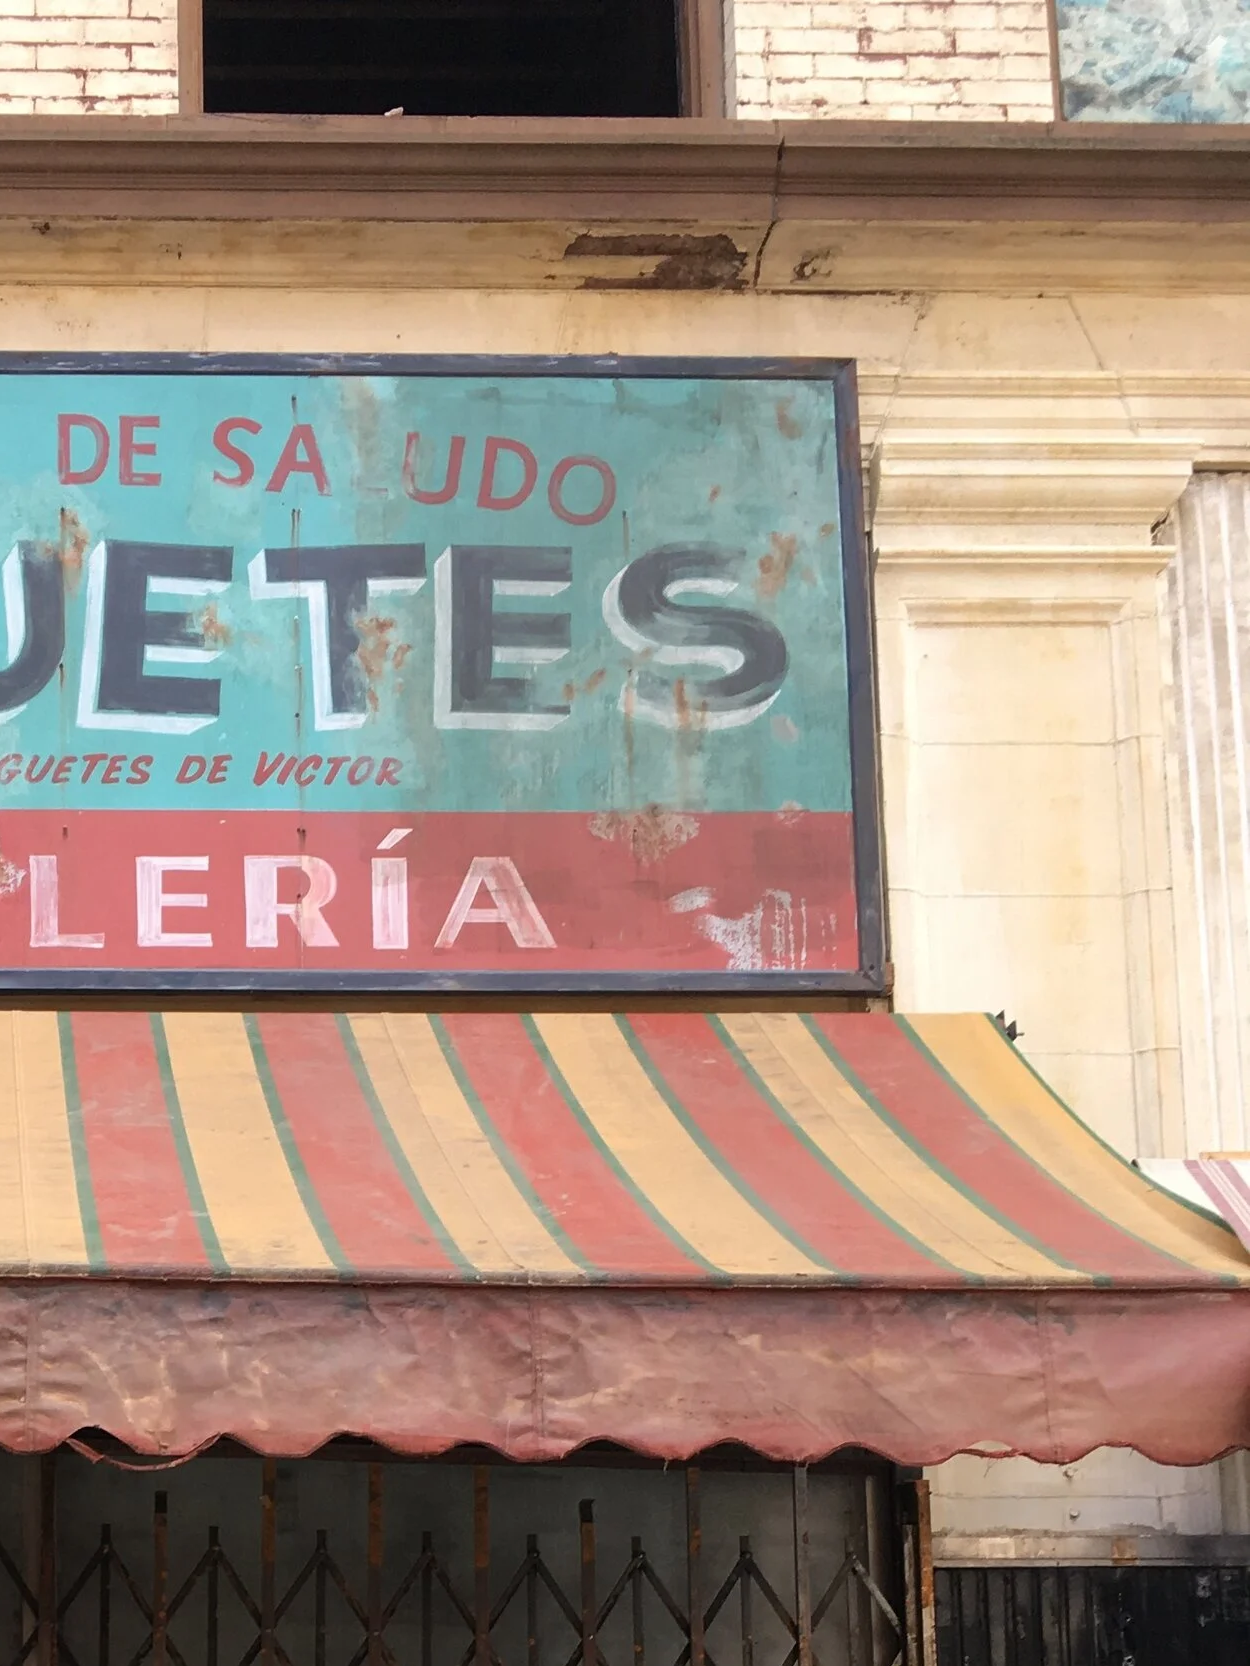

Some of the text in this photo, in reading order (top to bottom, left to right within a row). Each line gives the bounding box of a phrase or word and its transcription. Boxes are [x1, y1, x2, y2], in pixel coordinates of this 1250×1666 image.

[57, 413, 162, 486] DE
[213, 416, 617, 526] SAUDO
[175, 754, 233, 785] DE
[253, 751, 404, 787] VICTOR
